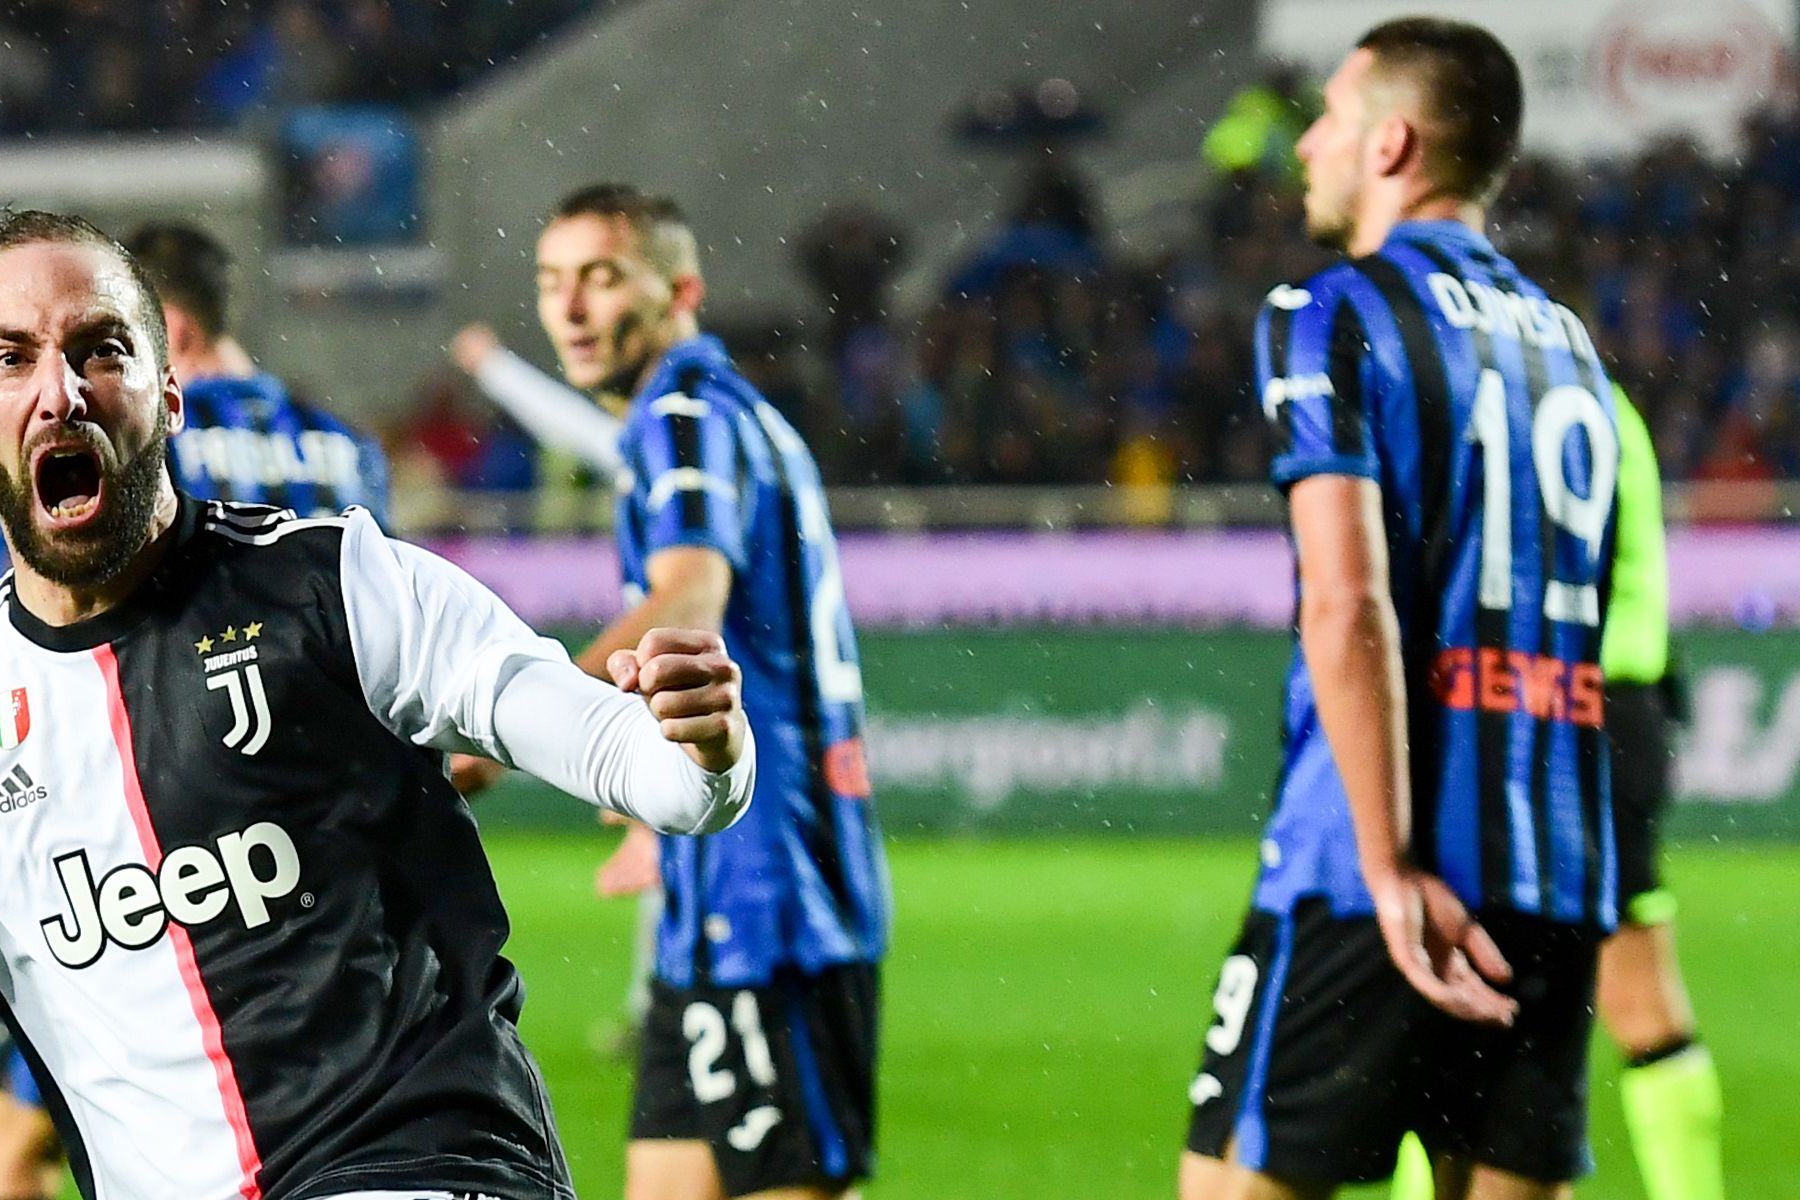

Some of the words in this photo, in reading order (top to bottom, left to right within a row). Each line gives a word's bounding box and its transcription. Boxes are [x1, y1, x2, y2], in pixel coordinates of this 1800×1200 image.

[203, 644, 258, 673] JUVENTUS
[39, 821, 300, 970] Jeep
[682, 988, 777, 1104] 21
